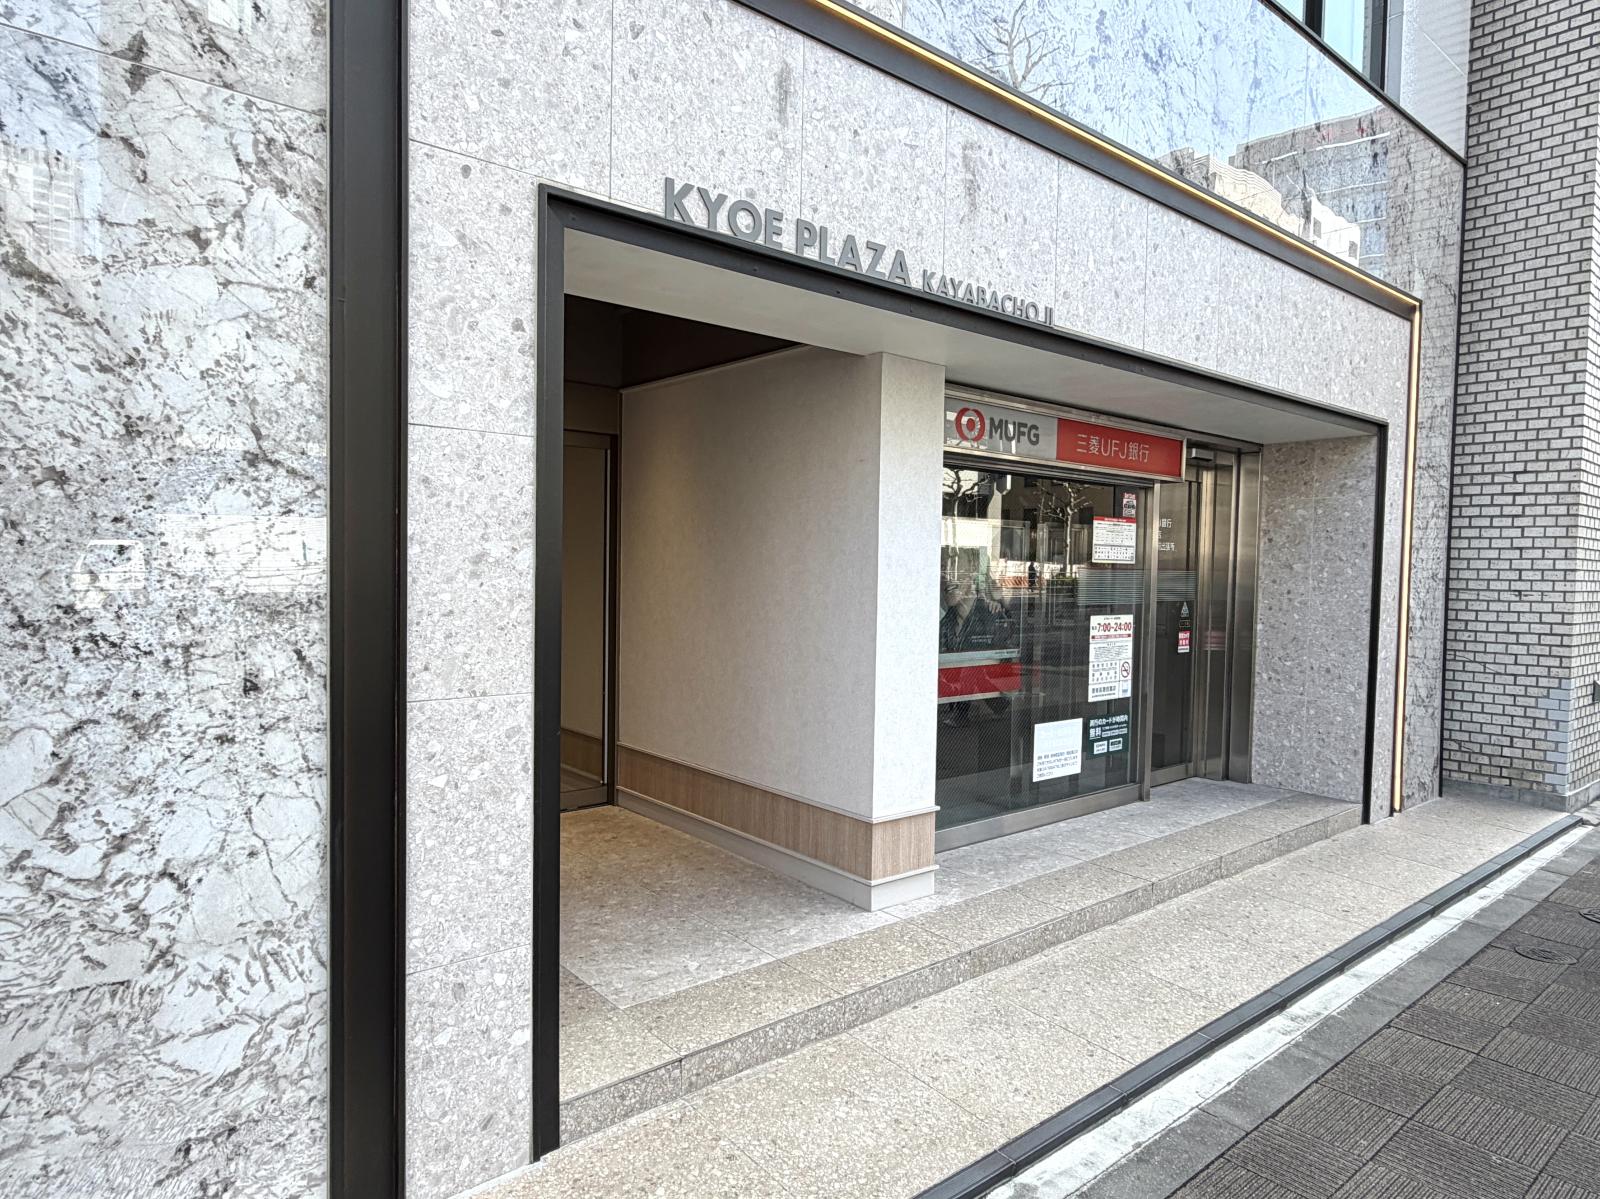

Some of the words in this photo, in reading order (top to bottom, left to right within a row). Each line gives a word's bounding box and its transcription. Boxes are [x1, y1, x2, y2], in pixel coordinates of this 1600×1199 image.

[664, 176, 784, 250] KYOE
[796, 217, 912, 289] PLAZA
[922, 268, 1040, 321] KAYABACHO
[989, 417, 1040, 446] MUFG
[1076, 433, 1150, 463] 三菱UFJ銀行
